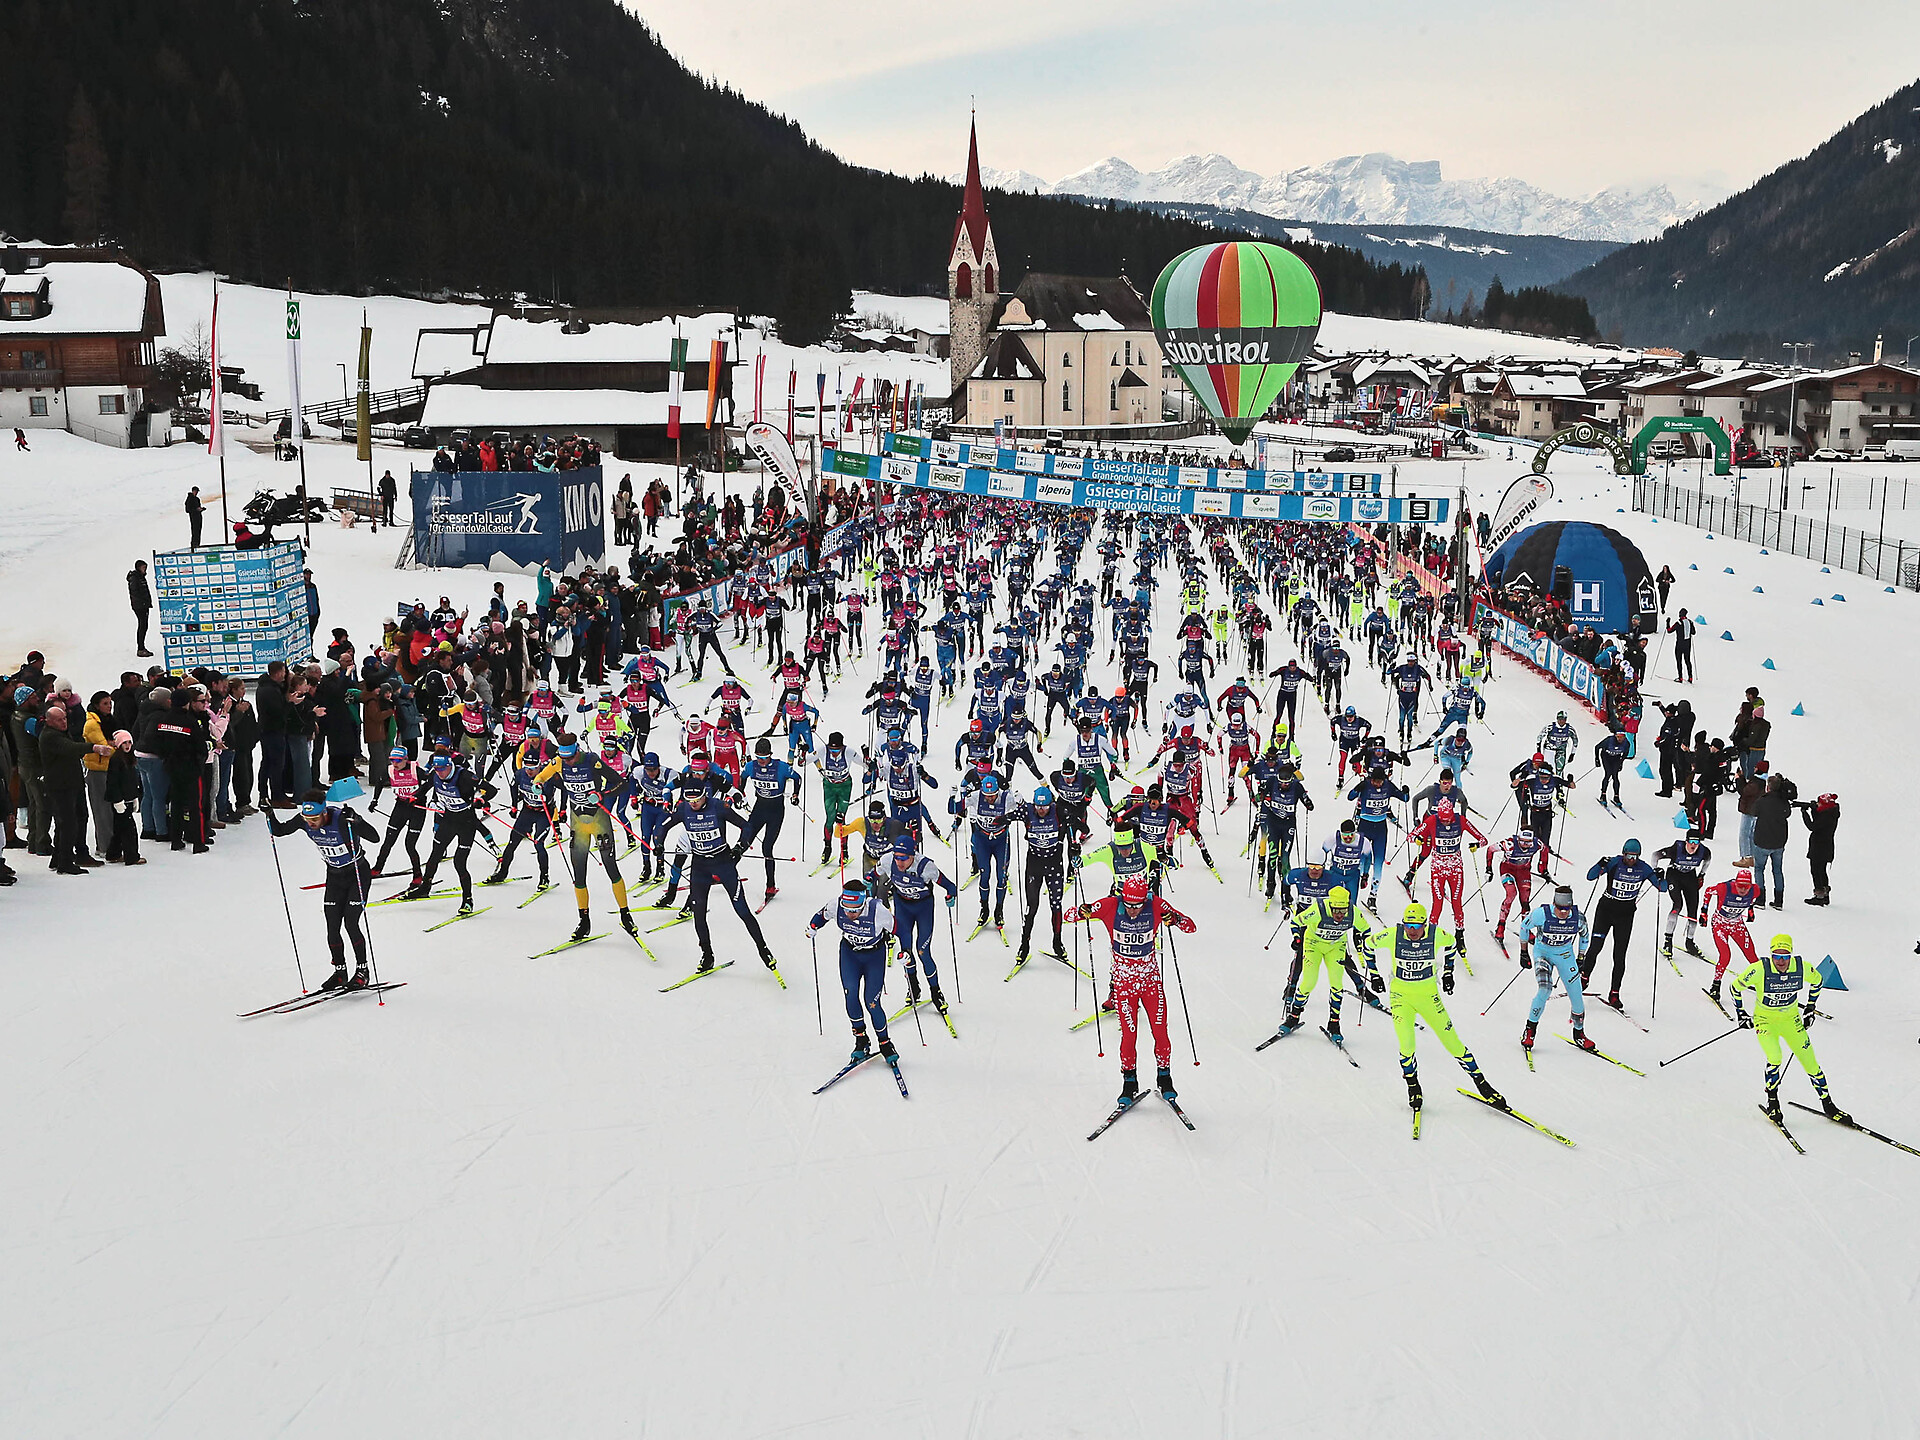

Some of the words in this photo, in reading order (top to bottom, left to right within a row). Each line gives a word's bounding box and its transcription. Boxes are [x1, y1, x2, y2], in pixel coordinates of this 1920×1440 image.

[1541, 433, 1572, 460] FORST
[1596, 433, 1625, 461] FORST
[973, 451, 994, 462] FORST
[1055, 460, 1082, 471] alperia
[1092, 459, 1170, 477] GsieserTalLauf
[933, 471, 962, 484] FORST
[1091, 471, 1169, 485] GranFondoValCasies
[1038, 484, 1072, 497] alperia
[1085, 483, 1182, 503] GsieserTalLauf
[563, 483, 587, 533] KM
[1084, 496, 1181, 514] GranFondoValCasies
[1312, 503, 1333, 512] mila
[1573, 583, 1600, 612] H
[571, 784, 586, 792] 520
[758, 781, 771, 789] 538
[696, 832, 712, 841] 503
[1147, 826, 1159, 834] 531
[1620, 882, 1635, 891] 518
[1124, 933, 1144, 944] 506
[1405, 961, 1424, 970] 507
[1155, 983, 1164, 1025] Internorm
